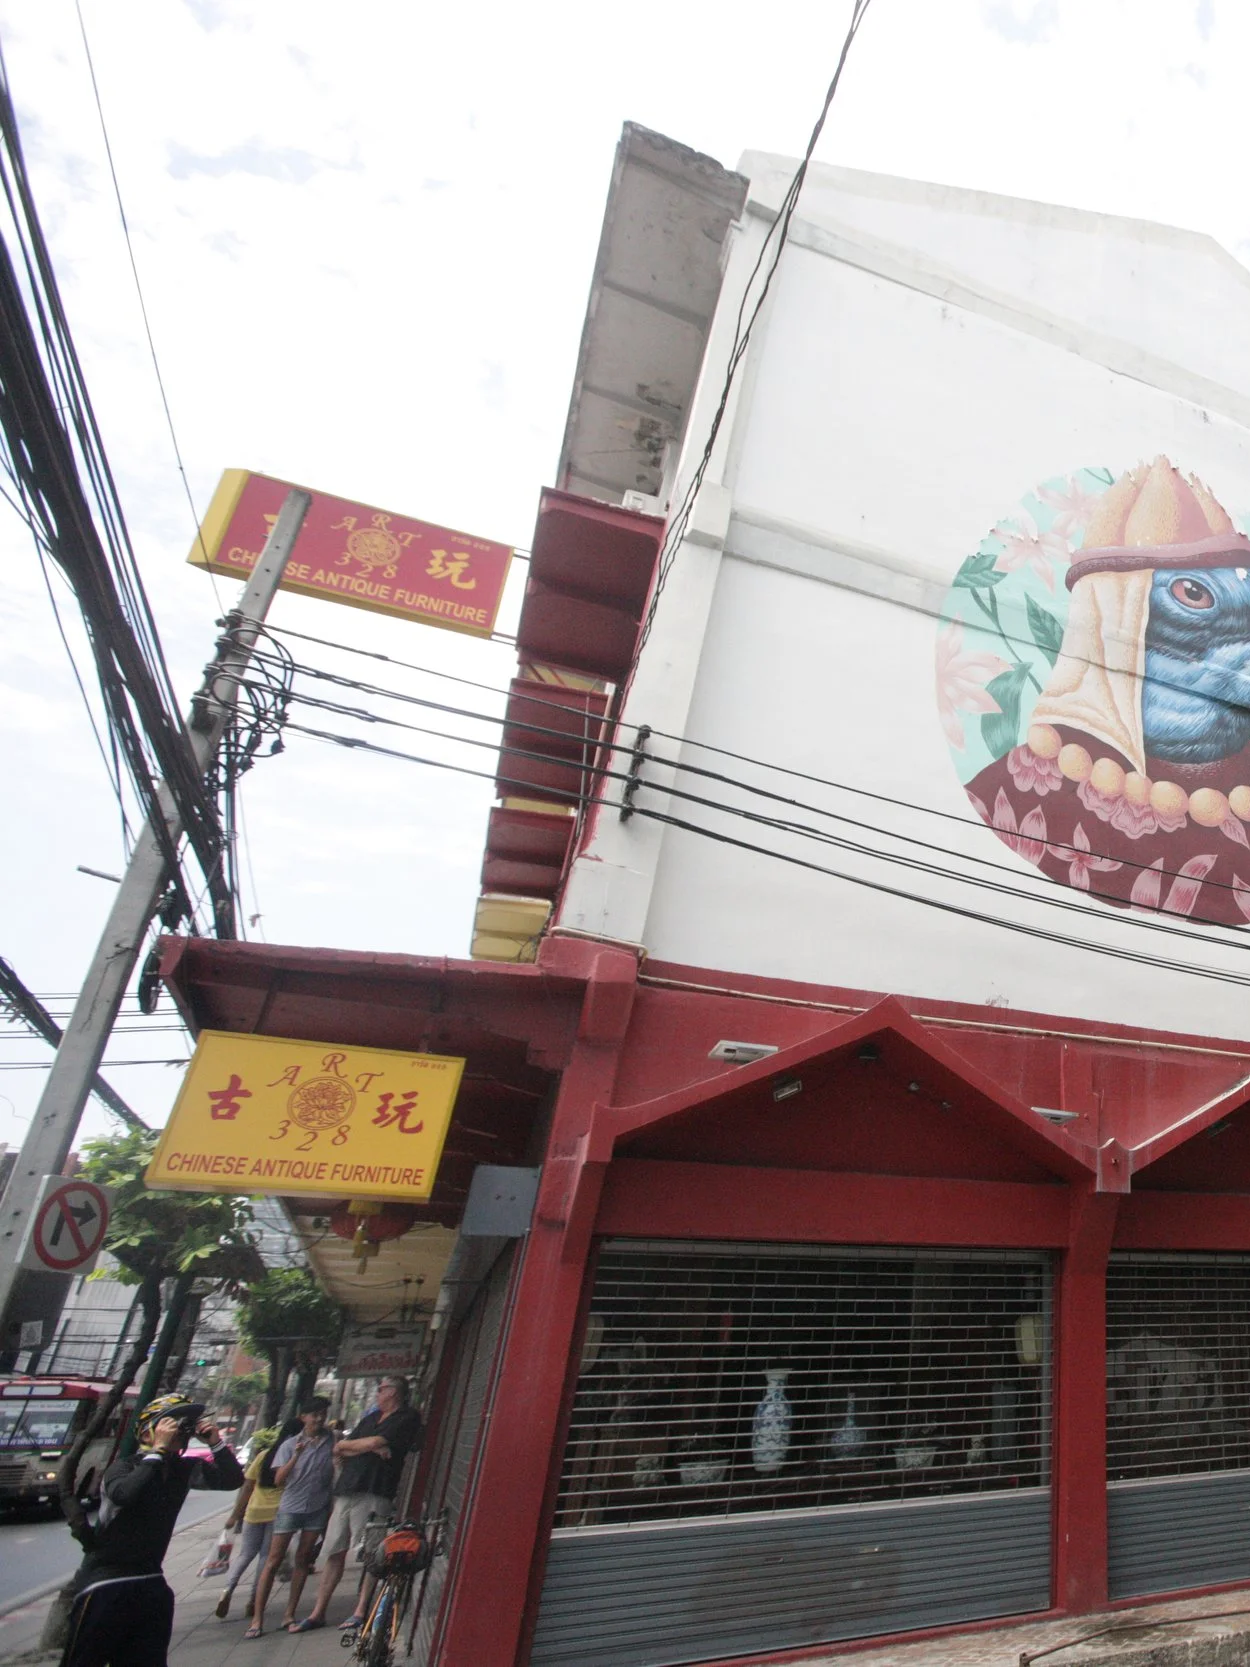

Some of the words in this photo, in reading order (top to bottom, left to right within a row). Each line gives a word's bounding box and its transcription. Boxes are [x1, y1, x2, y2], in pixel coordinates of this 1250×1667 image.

[331, 514, 421, 548] ART
[334, 553, 397, 579] 328
[425, 549, 475, 589] 玩
[228, 547, 310, 579] CHSE
[311, 573, 397, 599] ANTIQUE
[394, 589, 488, 623] FURNITURE
[266, 1052, 384, 1093] ART
[208, 1074, 252, 1120] 古
[371, 1091, 424, 1134] 玩
[269, 1119, 350, 1152] 328
[166, 1152, 248, 1175] CHINESE
[249, 1158, 329, 1180] ANTIQUE
[331, 1163, 425, 1186] FURNITURE
